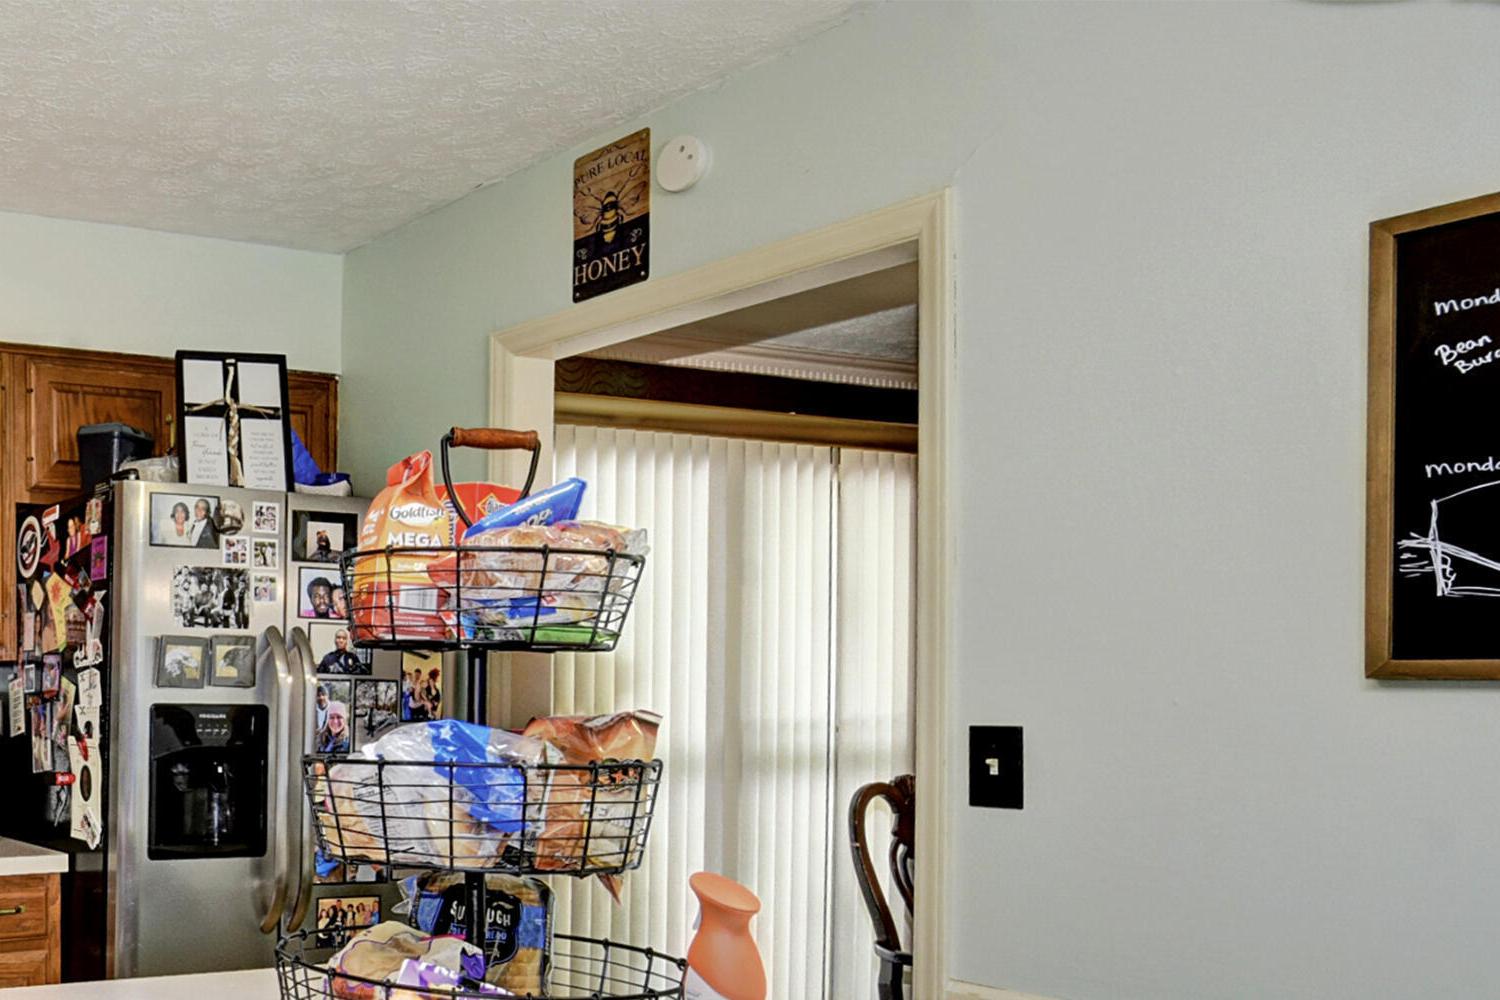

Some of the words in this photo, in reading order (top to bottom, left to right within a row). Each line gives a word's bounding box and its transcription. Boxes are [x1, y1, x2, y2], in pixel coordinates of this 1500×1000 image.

[574, 161, 605, 189] PURE
[607, 149, 648, 169] LOCAL
[573, 242, 647, 286] HONEY
[1434, 335, 1492, 365] Bean
[389, 506, 444, 521] Goldfish
[388, 531, 442, 547] MEGA
